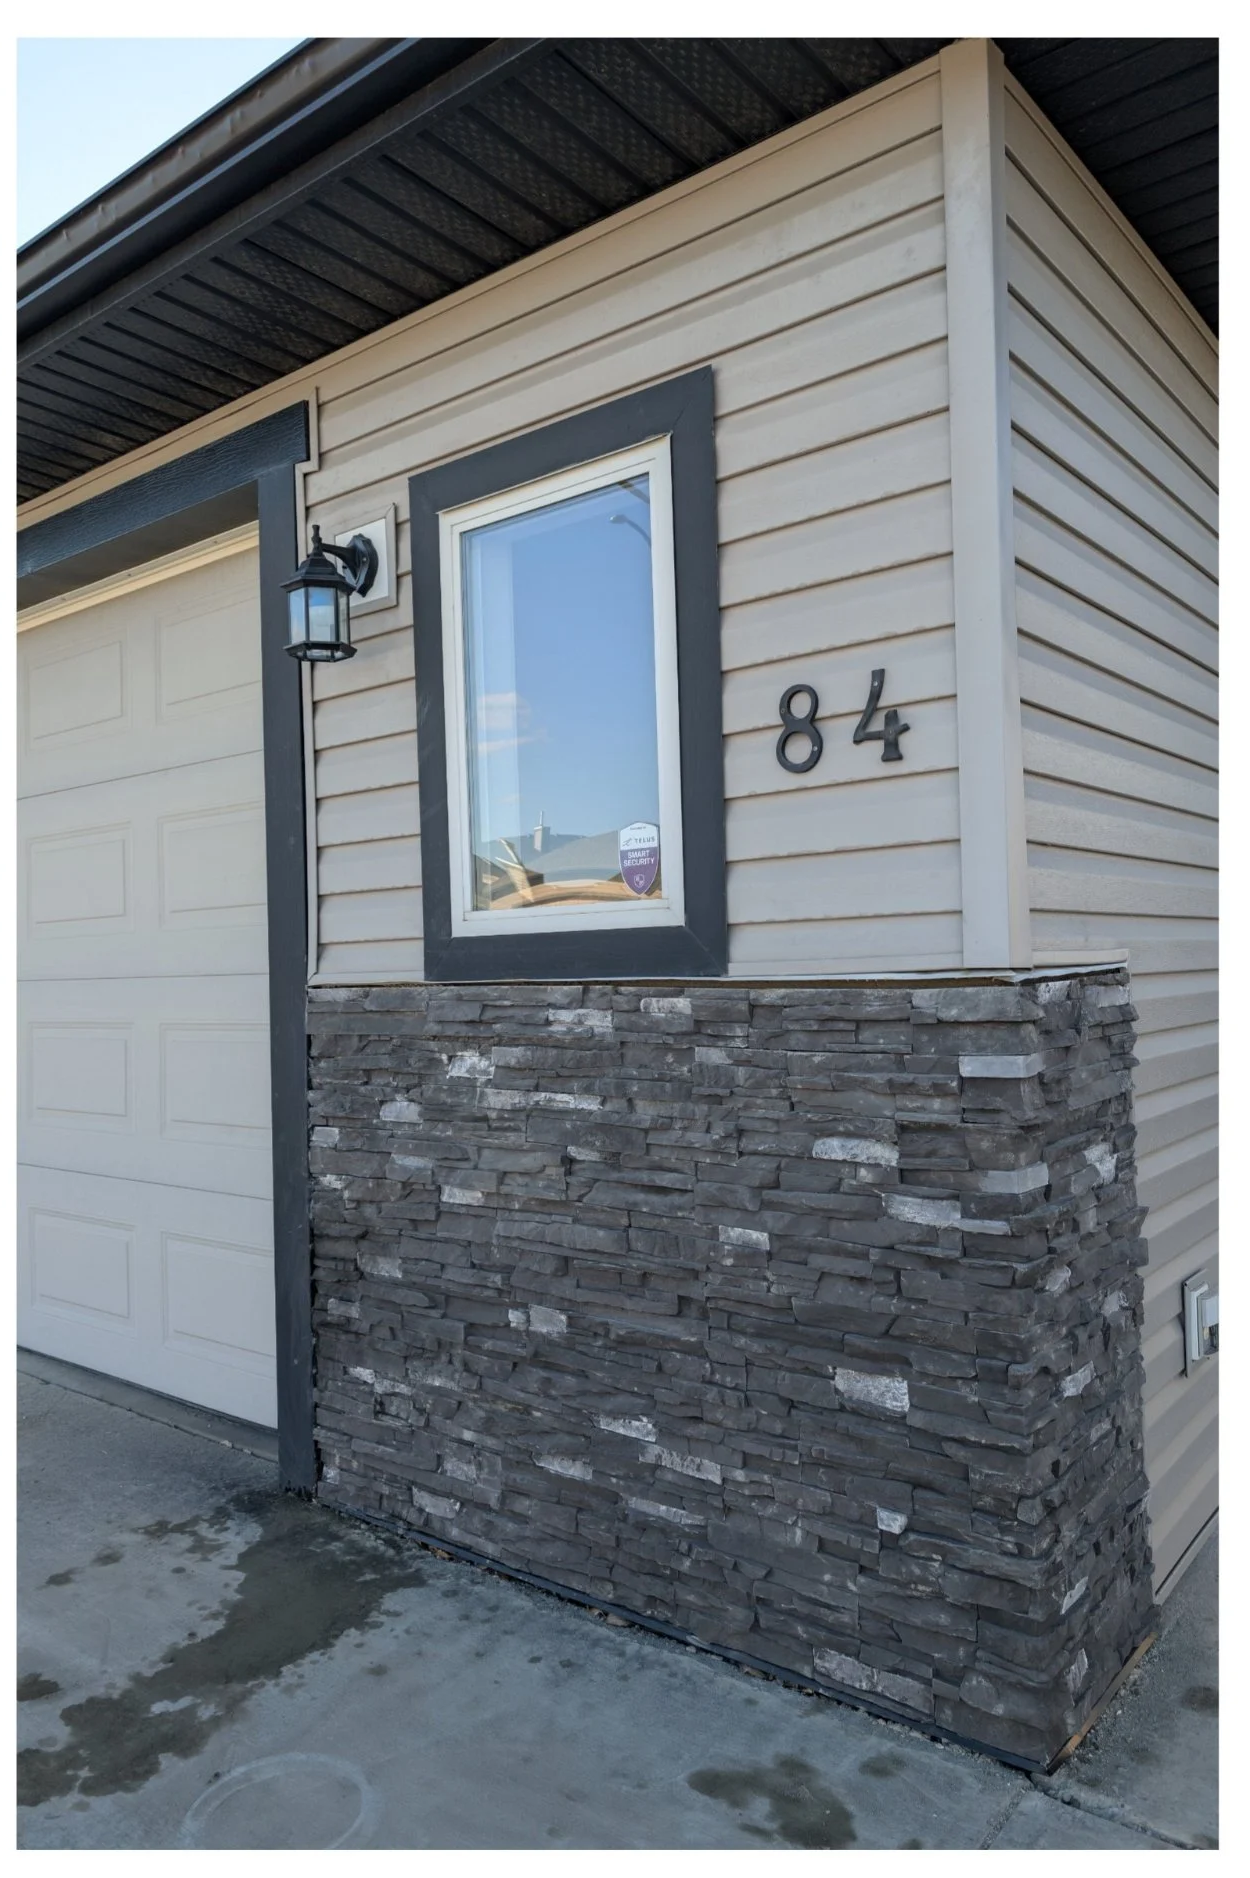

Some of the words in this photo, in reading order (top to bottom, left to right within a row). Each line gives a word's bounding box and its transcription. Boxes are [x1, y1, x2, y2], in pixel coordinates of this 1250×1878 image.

[776, 668, 910, 774] 84
[627, 850, 650, 859] SMART
[623, 857, 655, 867] SECURITY
